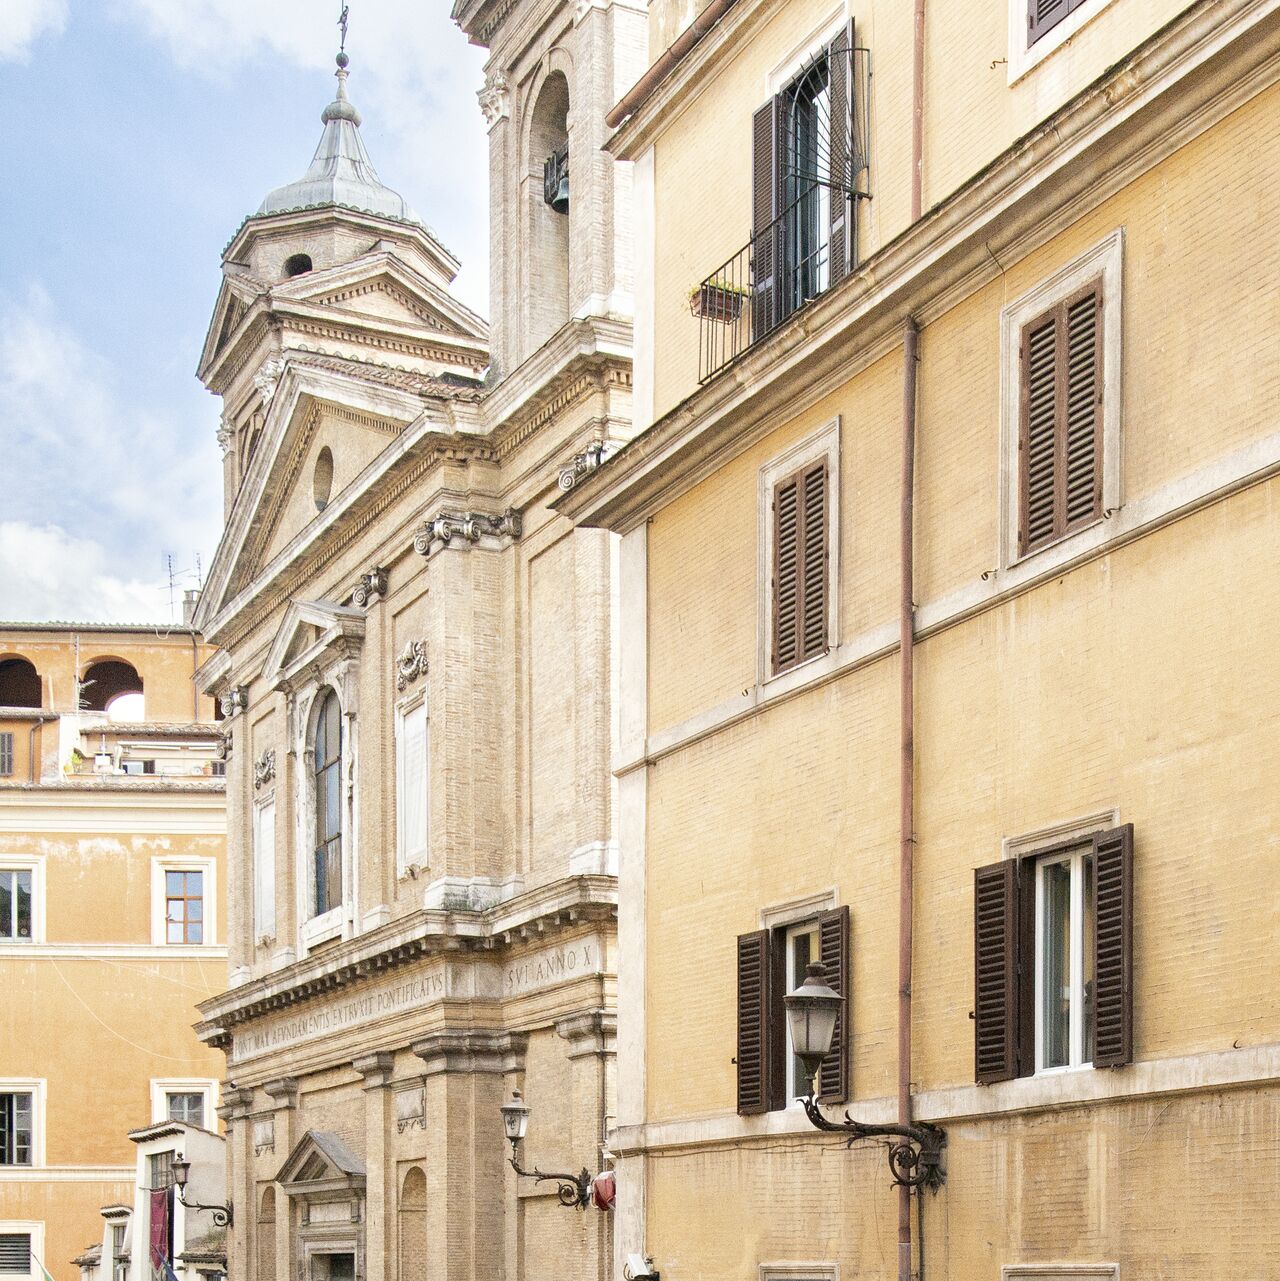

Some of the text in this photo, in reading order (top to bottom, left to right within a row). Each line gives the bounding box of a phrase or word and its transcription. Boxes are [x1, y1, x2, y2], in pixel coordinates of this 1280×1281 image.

[254, 1031, 269, 1050] MAX
[333, 996, 373, 1026] EXTRVXIT
[377, 972, 443, 1012] PONTIFICATVS
[506, 965, 528, 989] SVI
[536, 950, 576, 981] ANNO
[583, 945, 591, 966] X
